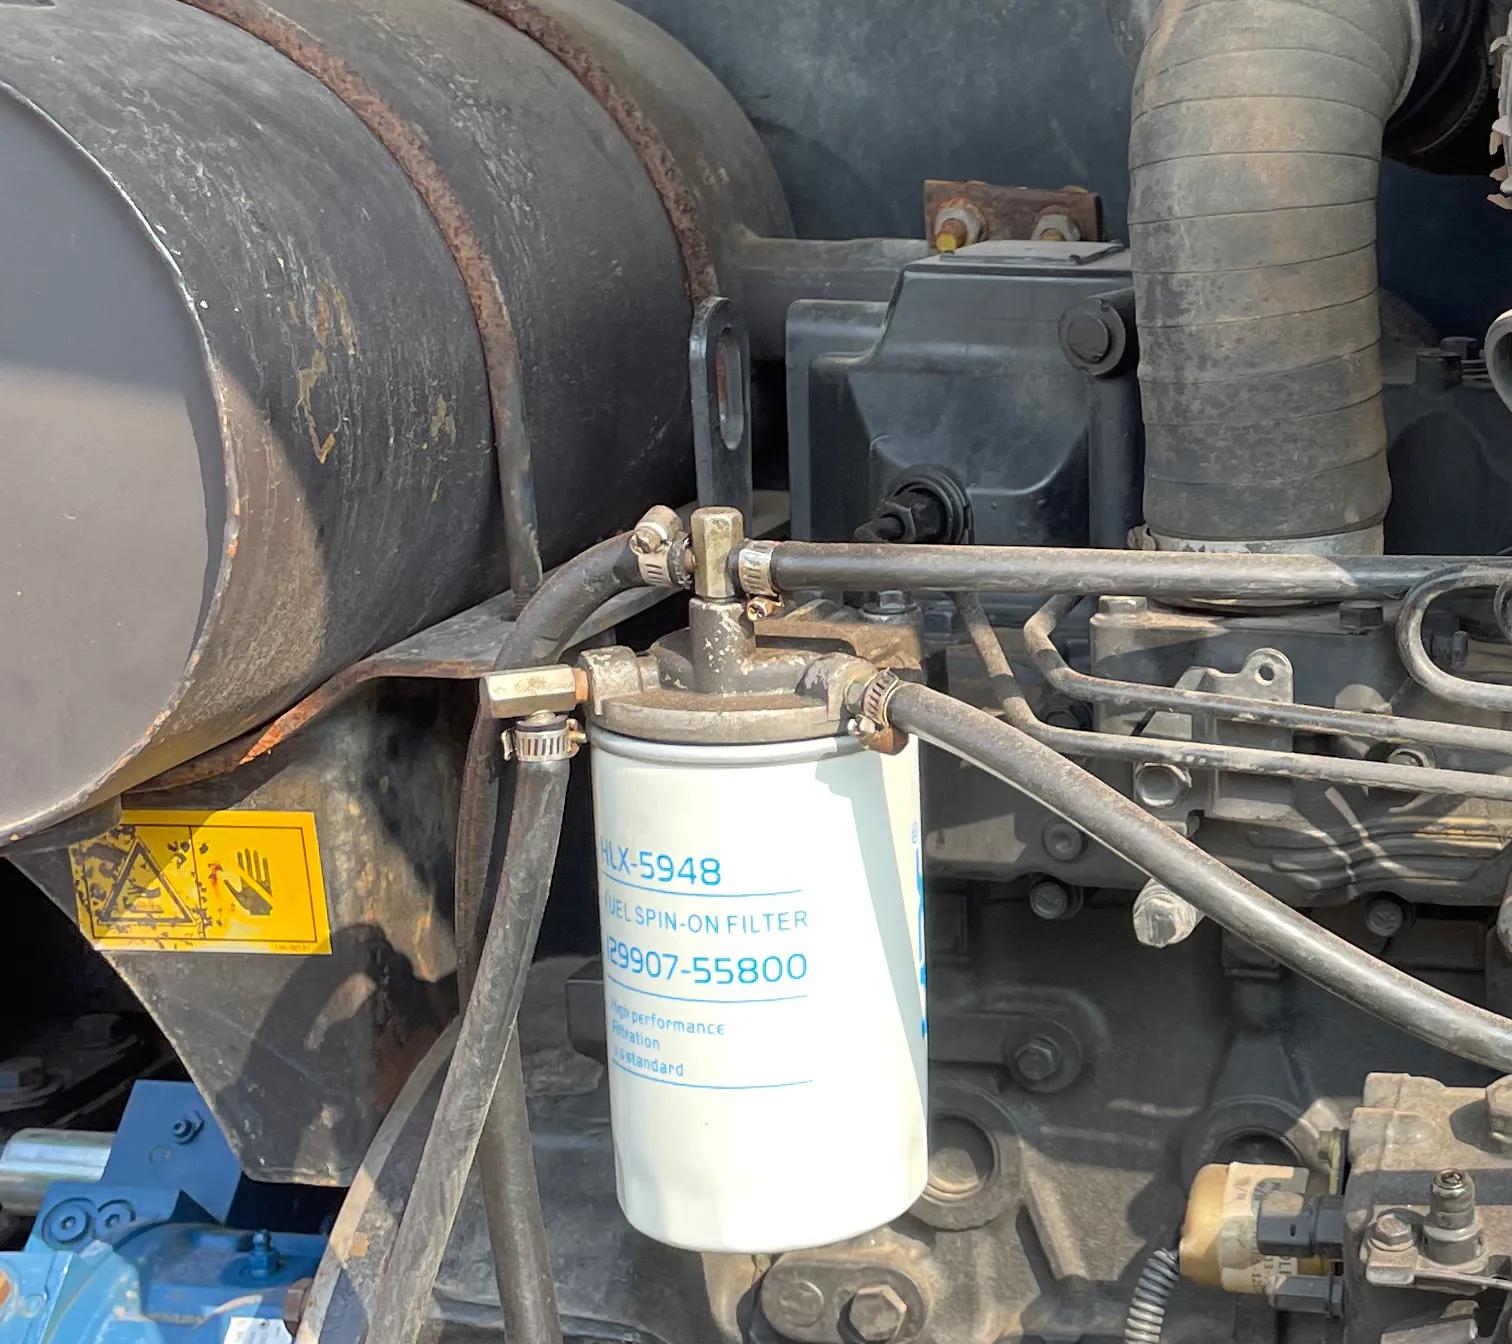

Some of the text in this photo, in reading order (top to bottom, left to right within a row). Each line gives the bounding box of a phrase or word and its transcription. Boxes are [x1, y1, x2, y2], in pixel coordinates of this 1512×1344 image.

[635, 905, 719, 934] SPIN-ON
[727, 910, 808, 934] FILTER
[632, 1010, 725, 1036] performance
[626, 1051, 684, 1077] standard
